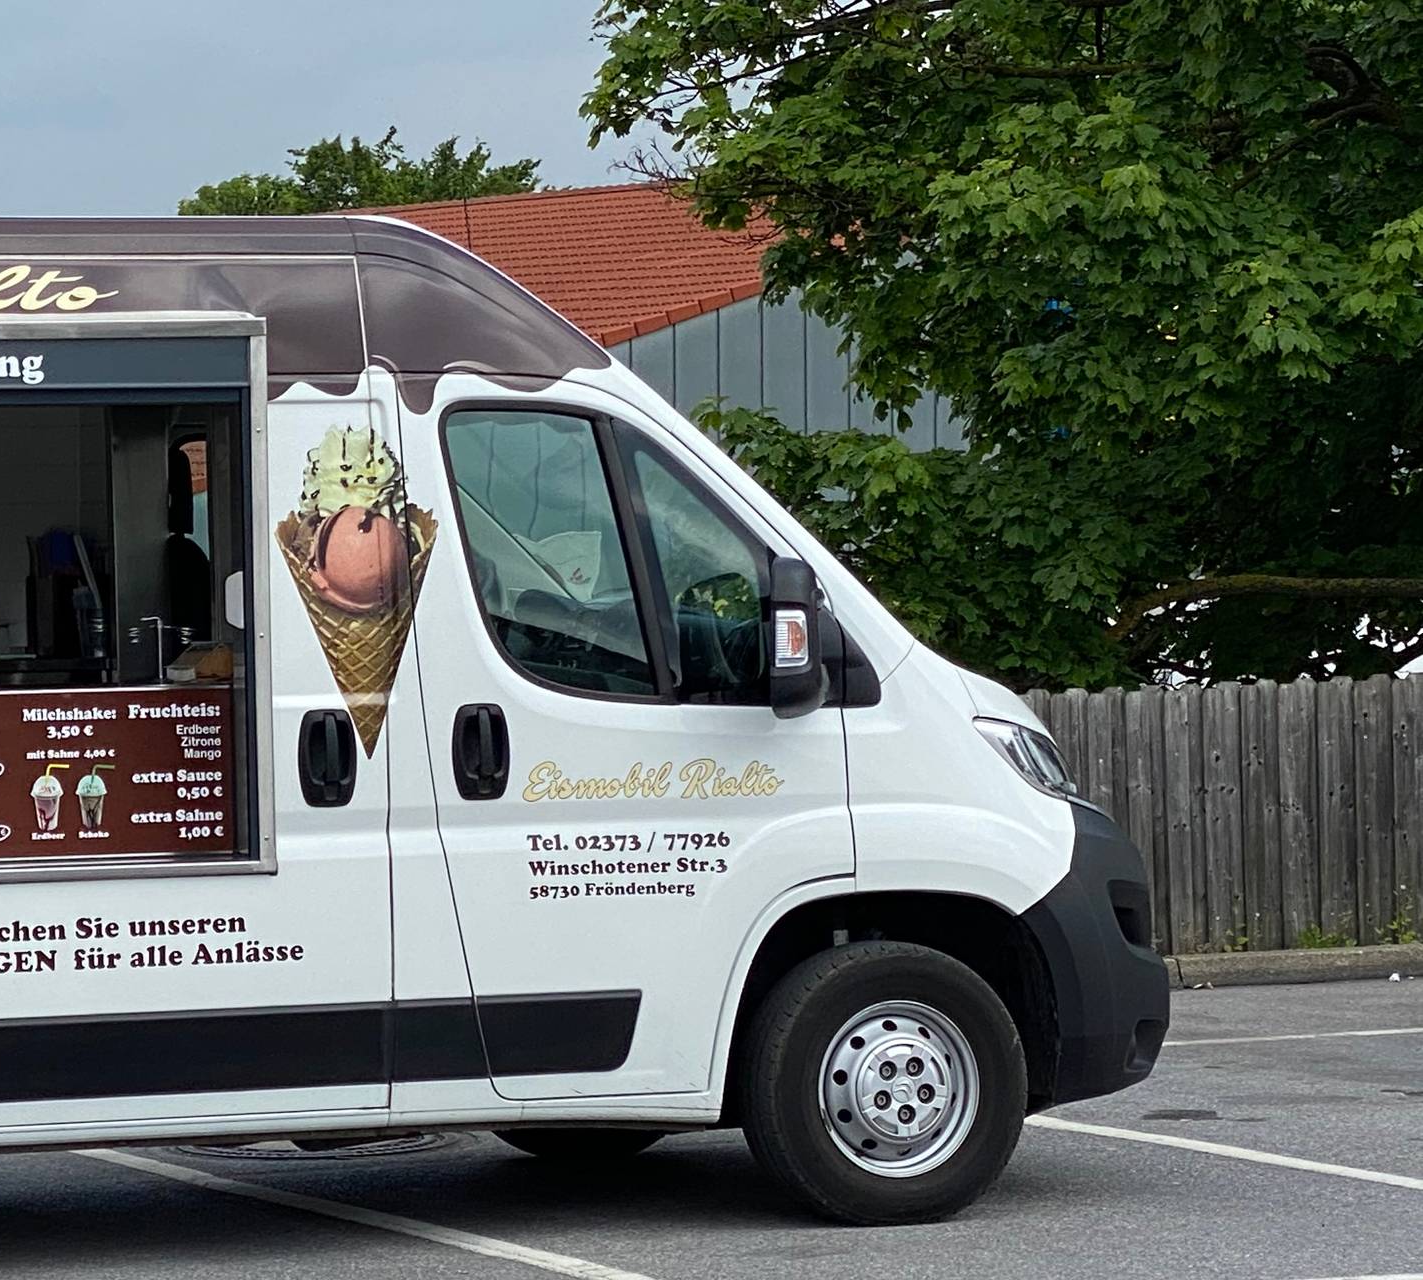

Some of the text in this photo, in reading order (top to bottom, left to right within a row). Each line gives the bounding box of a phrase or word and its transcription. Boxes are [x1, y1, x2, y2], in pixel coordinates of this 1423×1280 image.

[22, 708, 116, 721] Milchshake:
[128, 703, 221, 719] Fruchteis:
[47, 725, 94, 738] 3,50 €
[176, 725, 221, 735] Erdbeer
[181, 737, 221, 747] Zitrone
[27, 751, 45, 760] mit
[47, 750, 79, 759] Sahne
[84, 749, 107, 759] 4,00
[184, 749, 222, 760] Mango
[132, 769, 222, 783] extra Sauce
[523, 758, 785, 802] Eismobil Rialto
[177, 786, 223, 799] 0,50 €
[131, 810, 223, 823] extra Sahne
[179, 826, 224, 839] 1,00 €
[527, 832, 730, 853] Tel. 02373 / 77926
[529, 857, 728, 876] Winschotener Str.3
[530, 881, 696, 900] 58730 Fröndenberg
[76, 917, 119, 938] Sie
[129, 916, 247, 937] unseren
[74, 948, 122, 970] für
[130, 945, 183, 967] alle
[192, 939, 304, 966] Anlässe
